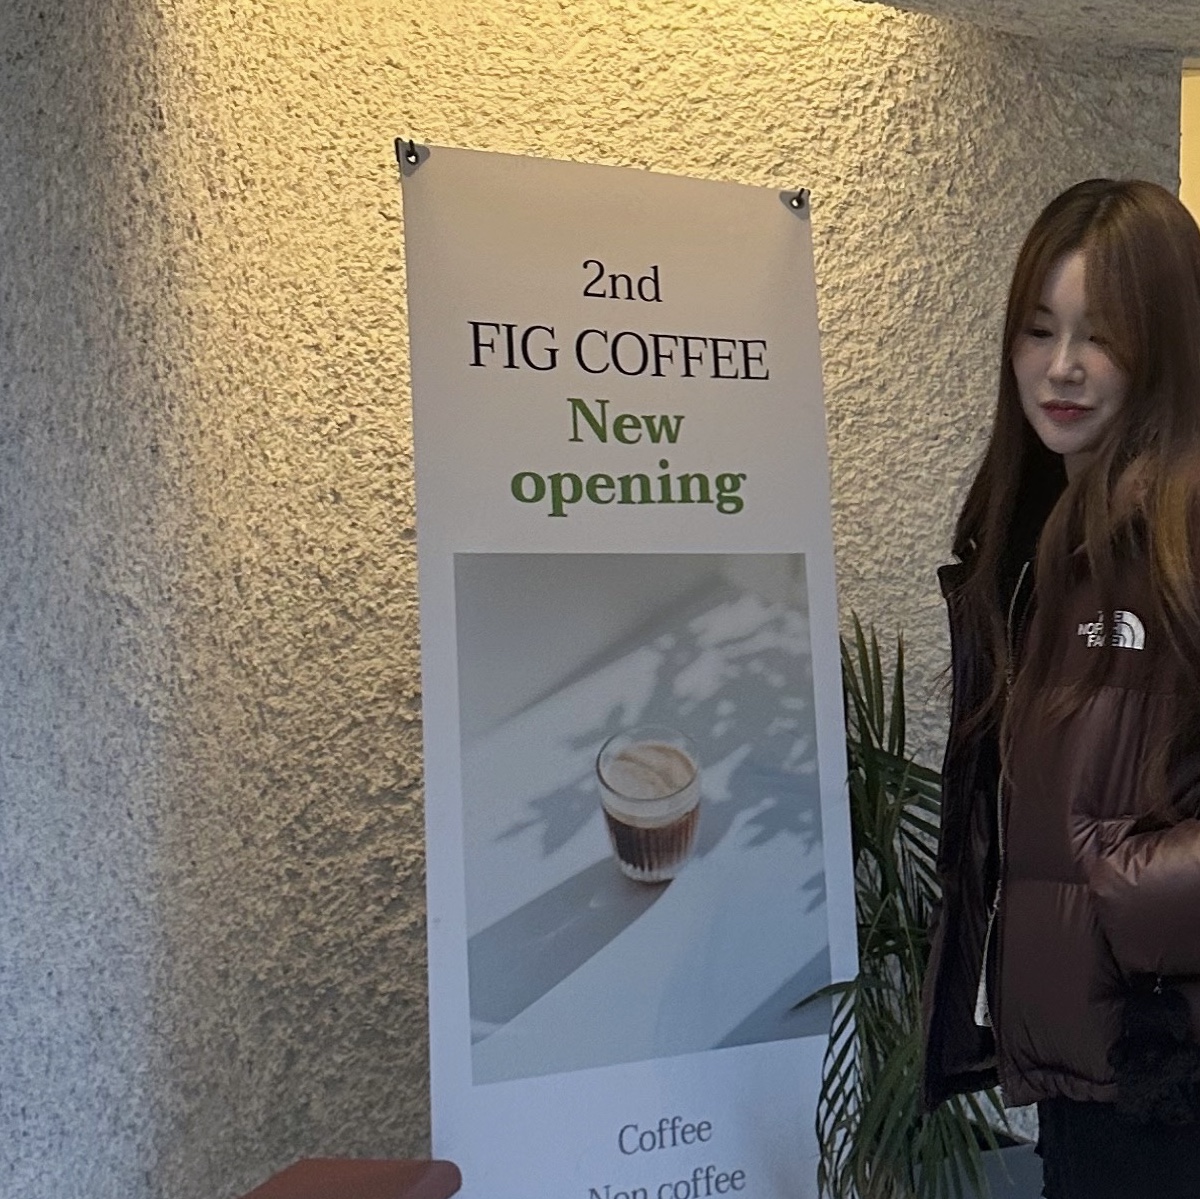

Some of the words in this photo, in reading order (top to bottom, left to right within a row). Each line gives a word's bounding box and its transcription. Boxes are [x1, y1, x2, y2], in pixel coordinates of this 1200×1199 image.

[582, 259, 663, 303] 2nd
[466, 320, 560, 372] FIG
[575, 328, 770, 381] COFFEE
[566, 397, 686, 445] New
[510, 458, 747, 518] opening
[1097, 610, 1123, 623] TE
[1087, 633, 1121, 648] FAE
[618, 1115, 713, 1156] Coffee
